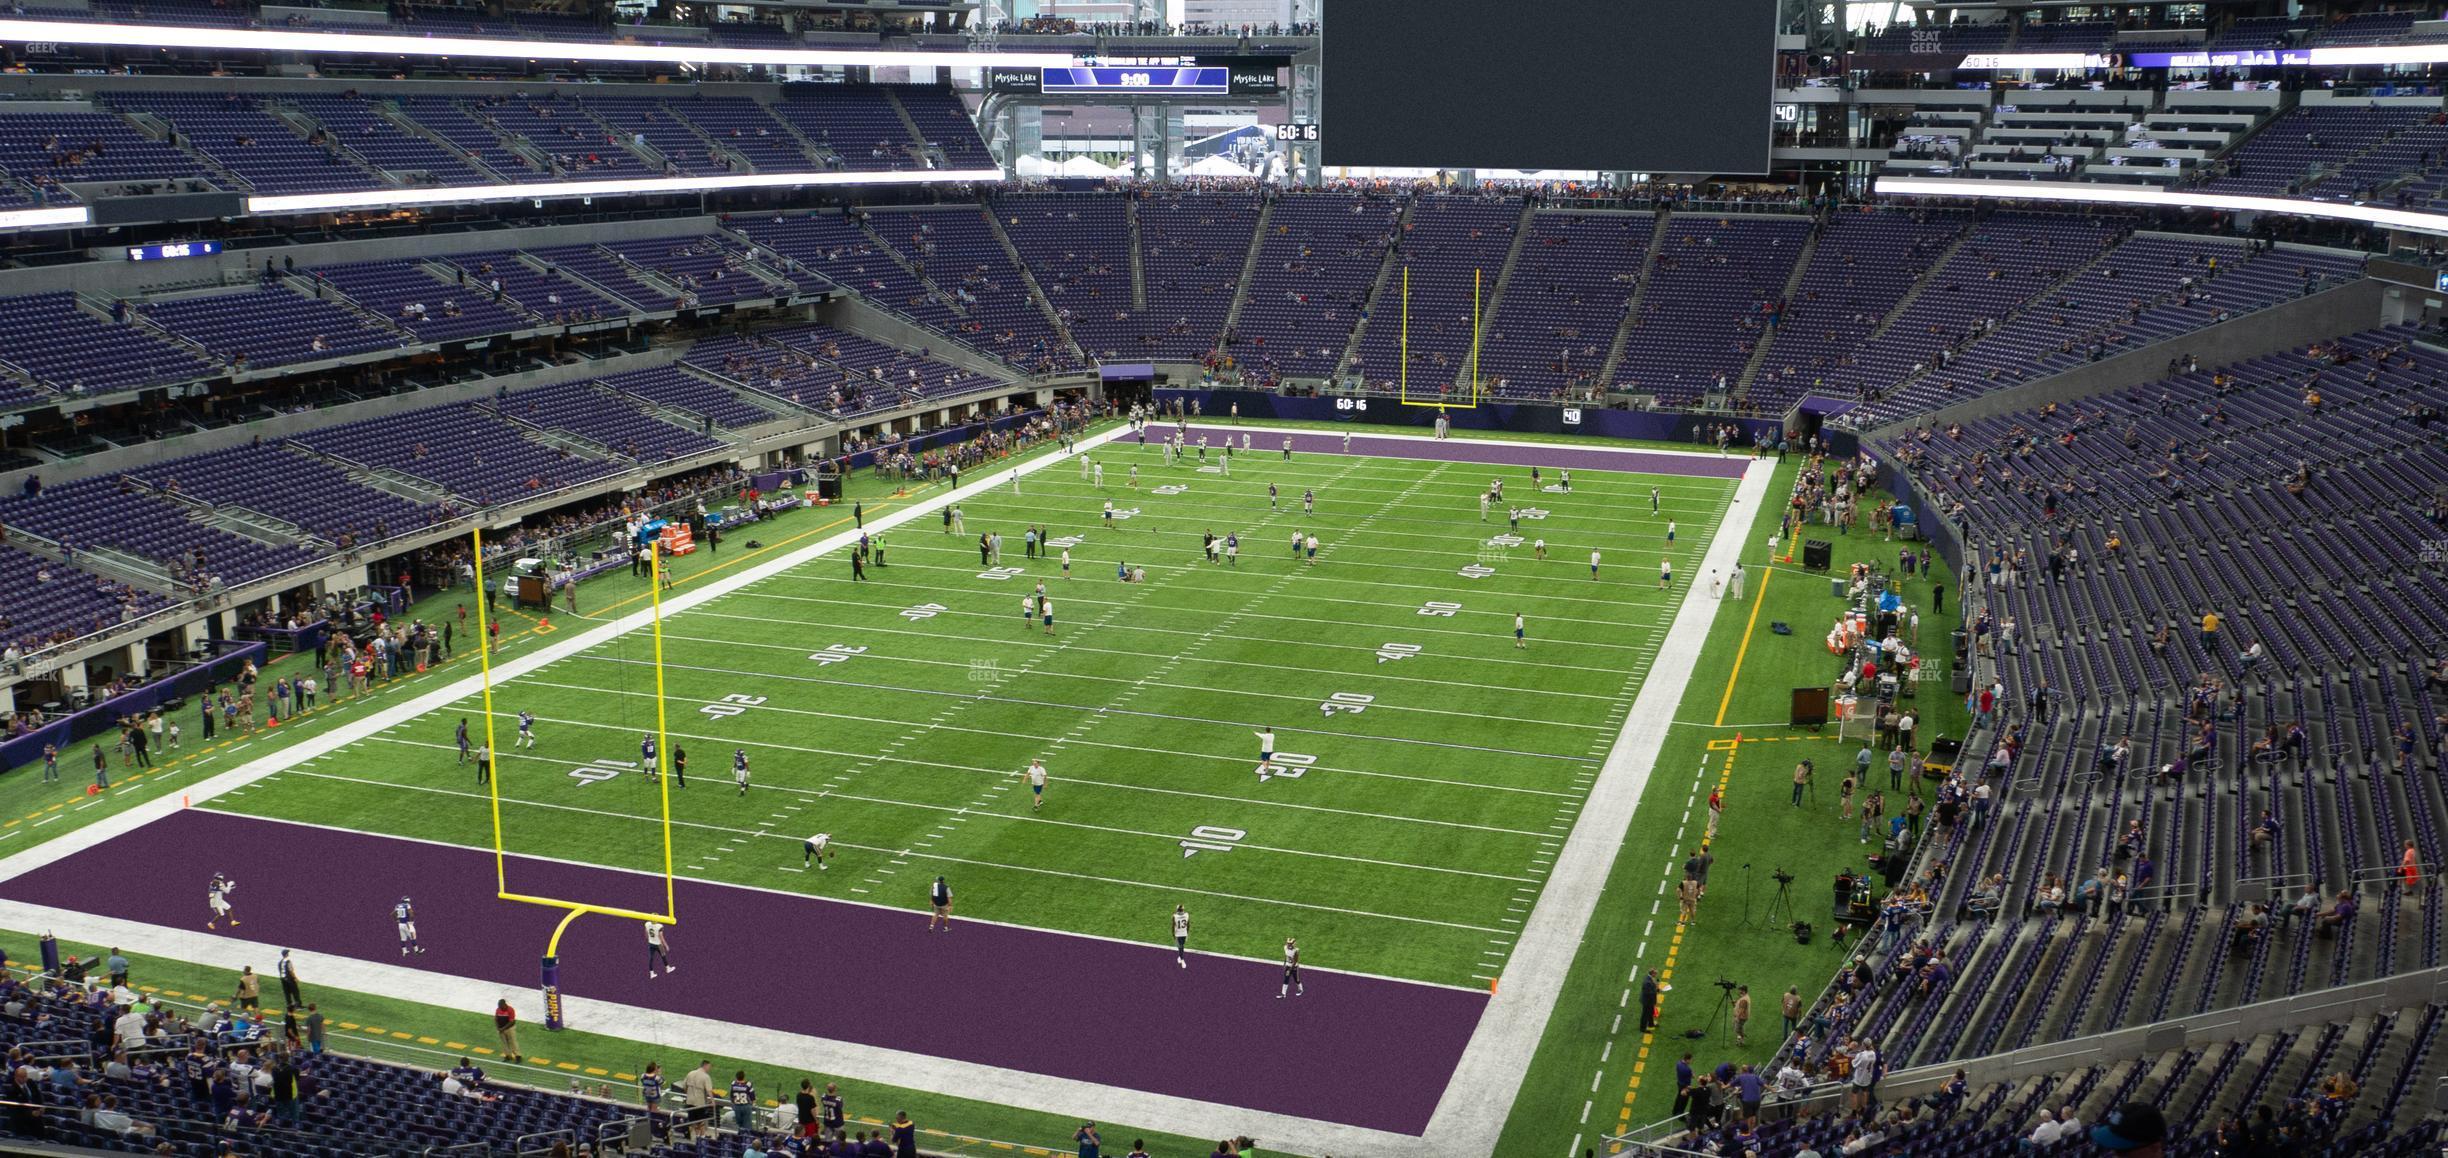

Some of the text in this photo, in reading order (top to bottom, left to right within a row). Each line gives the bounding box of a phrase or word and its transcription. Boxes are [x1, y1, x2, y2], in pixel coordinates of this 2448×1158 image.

[1966, 57, 1998, 68] 6016
[1120, 73, 1150, 86] 9:00
[1776, 105, 1796, 121] 40
[1278, 124, 1317, 140] 60:16
[1336, 398, 1367, 411] 60:16
[1564, 411, 1580, 421] 40
[975, 566, 1025, 580] 50
[899, 602, 949, 618] 40
[1416, 601, 1462, 617] 50
[807, 643, 869, 663] 30
[1375, 643, 1422, 660] 40
[699, 693, 768, 716] 20
[1319, 692, 1375, 714] 30
[566, 758, 638, 783] 10
[1254, 751, 1318, 779] 20
[1178, 824, 1247, 853] 10
[1176, 919, 1187, 929] 13
[187, 1064, 203, 1080] 52
[733, 1092, 748, 1105] 28
